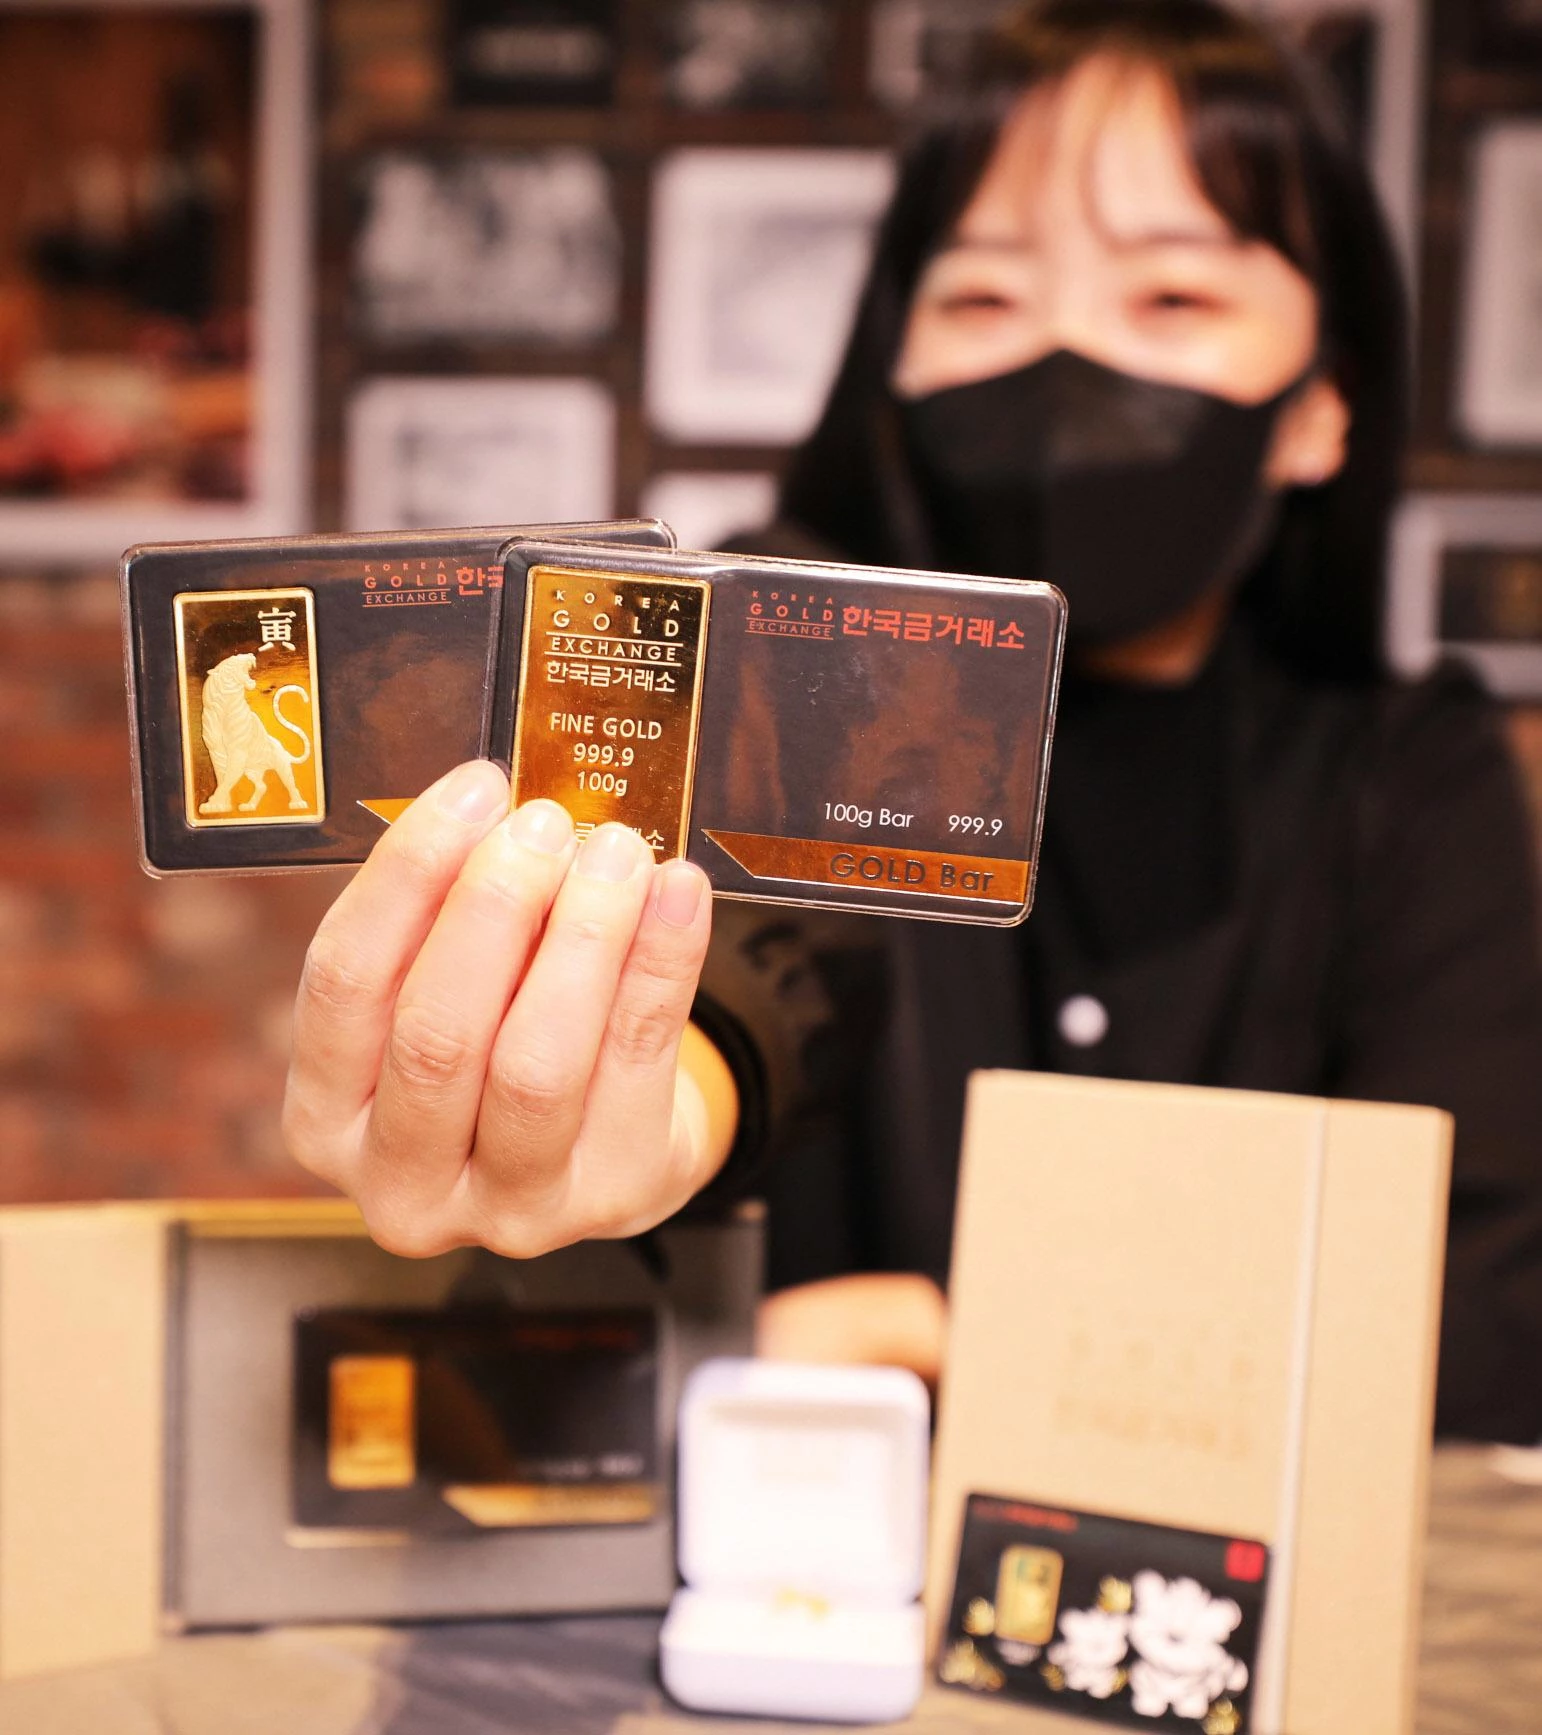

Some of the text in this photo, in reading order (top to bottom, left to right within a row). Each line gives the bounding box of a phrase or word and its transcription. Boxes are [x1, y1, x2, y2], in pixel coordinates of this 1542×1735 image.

[364, 560, 446, 572] KOREA
[364, 573, 448, 589] GOLD
[366, 591, 447, 605] EXCHANGE
[556, 589, 680, 611] KOREA
[751, 590, 833, 604] KOREA
[553, 609, 680, 637] GOLD
[750, 603, 833, 621] GOLD
[257, 608, 296, 652] 寅
[749, 620, 832, 638] EXCHANGE
[843, 606, 1025, 649] 한국금거래소
[550, 636, 677, 661] EXCHANGE
[547, 661, 675, 692] 한국금거래소
[550, 713, 662, 740] FINE GOLD
[574, 743, 634, 767] 999.9
[578, 772, 628, 796] 100g
[824, 802, 1003, 836] 100g Bar 999.9
[831, 853, 994, 893] GOLD Bar
